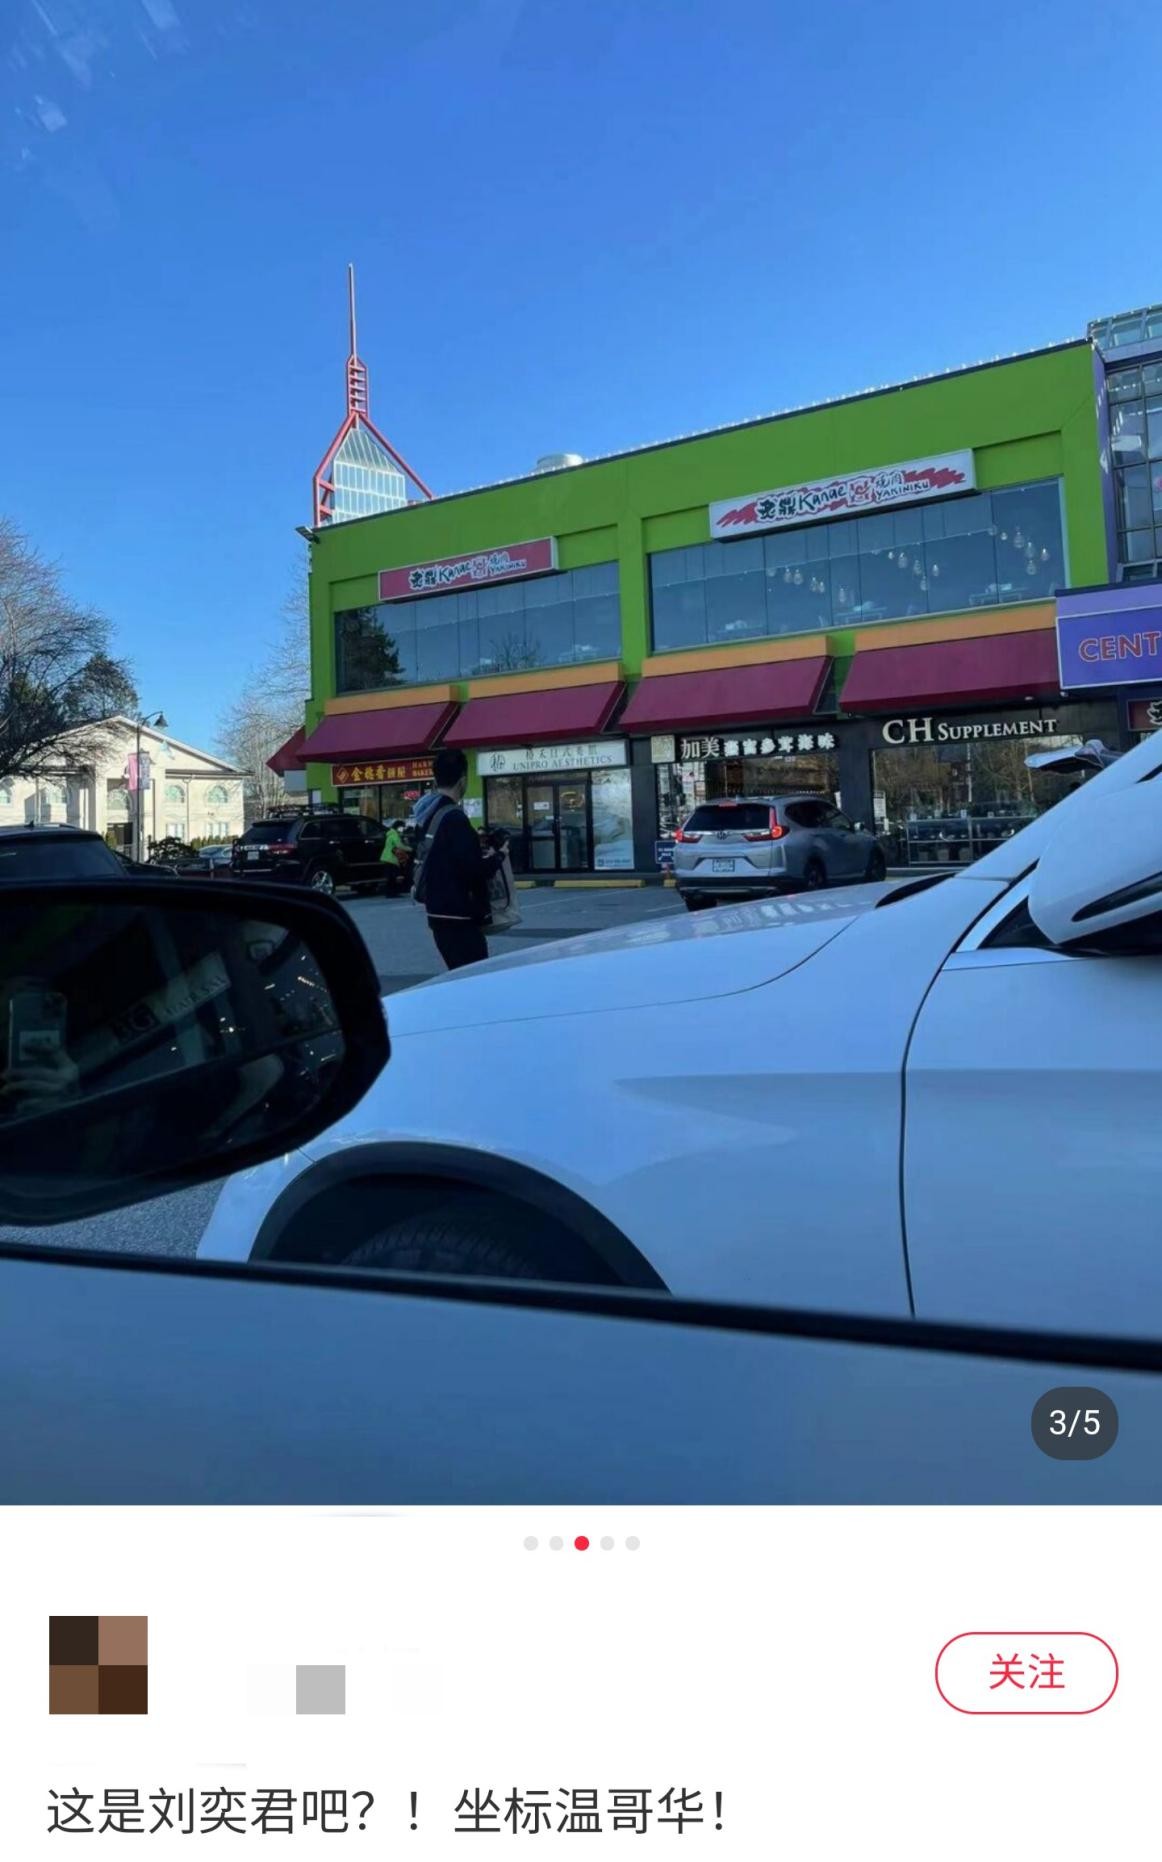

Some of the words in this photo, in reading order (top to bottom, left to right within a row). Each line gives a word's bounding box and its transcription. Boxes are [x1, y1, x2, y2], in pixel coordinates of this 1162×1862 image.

[801, 485, 846, 511] Kanae
[876, 480, 929, 500] YAKINIKU
[440, 561, 471, 582] Kanae
[882, 717, 935, 744] CH
